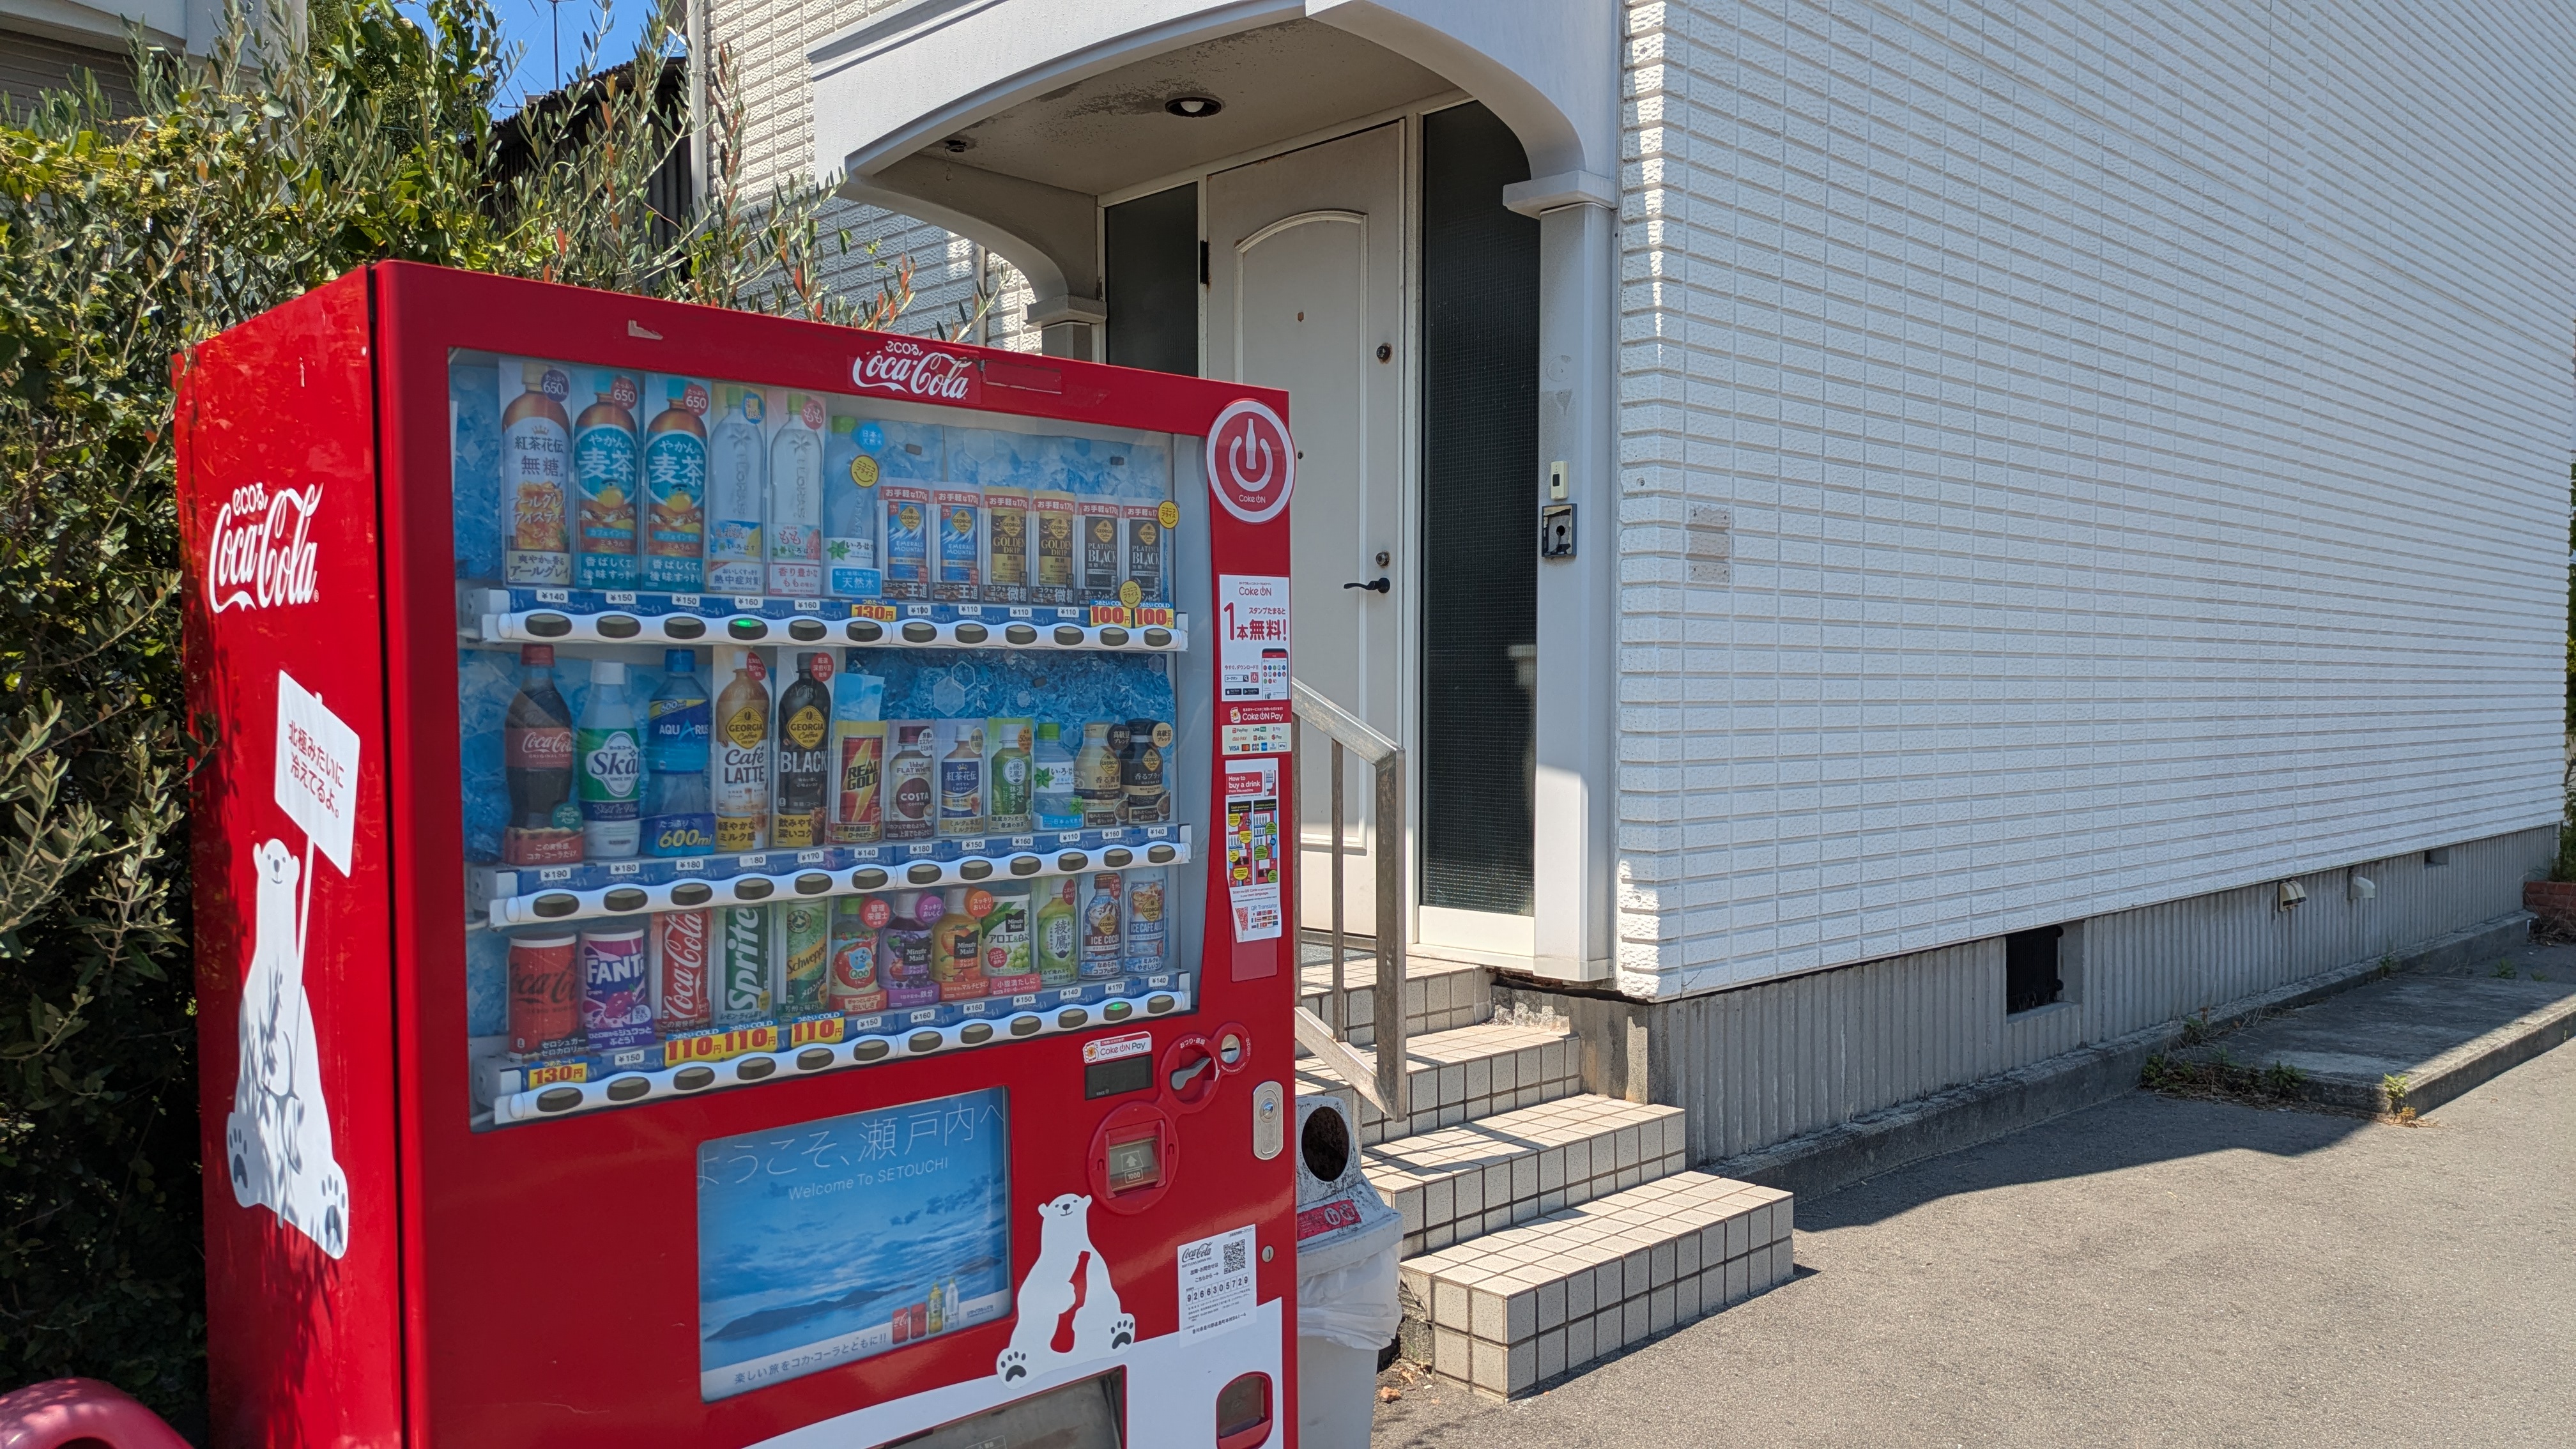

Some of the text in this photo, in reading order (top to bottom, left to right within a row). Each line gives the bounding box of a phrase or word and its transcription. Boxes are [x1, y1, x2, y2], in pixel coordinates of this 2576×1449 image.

[613, 389, 636, 403] 650
[686, 395, 707, 410] 650
[802, 408, 823, 424] もも
[514, 435, 564, 454] 紅茶花伝
[578, 447, 636, 482] 麦茶
[648, 453, 704, 487] 麦茶
[857, 459, 877, 471] ニコニコ
[1239, 494, 1255, 503] Coke
[779, 531, 802, 545] もも
[209, 482, 323, 613] Coca-Cola
[518, 554, 565, 566] 爽やかに香る
[1087, 549, 1117, 563] BLACK
[1131, 552, 1160, 565] BLACK
[510, 565, 569, 579] アールグレイ
[778, 567, 818, 578] 香り豊かな
[842, 576, 875, 589] 天然水
[541, 592, 565, 601] ¥140
[1006, 586, 1027, 602] 微糖
[1054, 588, 1073, 603] 微糖
[1238, 585, 1272, 597] Coke ON
[610, 594, 633, 602] ¥150
[675, 595, 697, 605] ¥150
[738, 597, 758, 606] ¥160
[854, 605, 894, 621] 130円
[1091, 606, 1131, 624] 100円
[1135, 608, 1174, 626] 100円
[1223, 601, 1287, 641] 1本無料!
[1242, 711, 1284, 722] Coke ON Pay
[659, 719, 709, 741] AQUARIUS
[728, 723, 763, 733] GEORGIA
[790, 723, 825, 731] GEORGIA
[288, 719, 344, 790] 北極みたいに
[724, 745, 765, 766] Café
[779, 750, 828, 773] BLACK
[724, 766, 765, 784] LATTE
[847, 759, 878, 779] REAL
[847, 772, 878, 791] GOLD
[946, 770, 977, 781] 紅茶花伝
[291, 750, 340, 820] 冷えてるよ。
[1229, 781, 1239, 790] buy
[1245, 779, 1261, 788] drink
[900, 792, 930, 801] COSTA
[717, 821, 756, 831] 軽やかな
[658, 829, 713, 849] 600ml
[719, 832, 756, 842] ミルク感
[778, 829, 813, 839] 深いコク
[801, 852, 820, 861] ¥170
[615, 864, 637, 872] ¥180
[680, 861, 701, 869] ¥180
[544, 870, 568, 879] ¥190
[923, 903, 941, 911] スッキリ
[972, 903, 991, 911] おいしく
[1131, 923, 1153, 933] ICE CAFE
[1054, 919, 1068, 951] 綾鷹
[1091, 936, 1103, 945] ICE
[906, 947, 927, 956] Minute
[959, 947, 975, 956] Maid
[726, 906, 763, 1011] Sprite
[908, 954, 925, 962] Maid
[664, 912, 703, 1020] Coca-Cola
[850, 968, 870, 979] Qoo
[997, 978, 1036, 988] 小腹満たしに
[1107, 983, 1123, 992] ¥170
[851, 1002, 875, 1011] おいしさ
[913, 1011, 931, 1020] ¥160
[751, 1020, 773, 1028] COLD
[861, 1018, 878, 1027] ¥150
[695, 1028, 719, 1037] COLD
[793, 1019, 843, 1043] 110円
[610, 1037, 636, 1046] ぶどう!
[724, 1027, 776, 1052] 110円
[668, 1036, 722, 1061] 110円
[1100, 1041, 1146, 1056] Coke ON Pay
[618, 1054, 641, 1062] ¥150
[533, 1065, 584, 1084] 130円
[698, 1102, 1004, 1189] ようこそ、瀬戸内へ
[788, 1157, 949, 1200] Welcome To SETOUCHI
[1127, 1172, 1141, 1181] 1000
[1181, 1241, 1213, 1263] Coca-Cola
[1194, 1273, 1213, 1283] こちらから
[734, 1331, 887, 1385] 楽しい旅をコカ・コーラとともに!!
